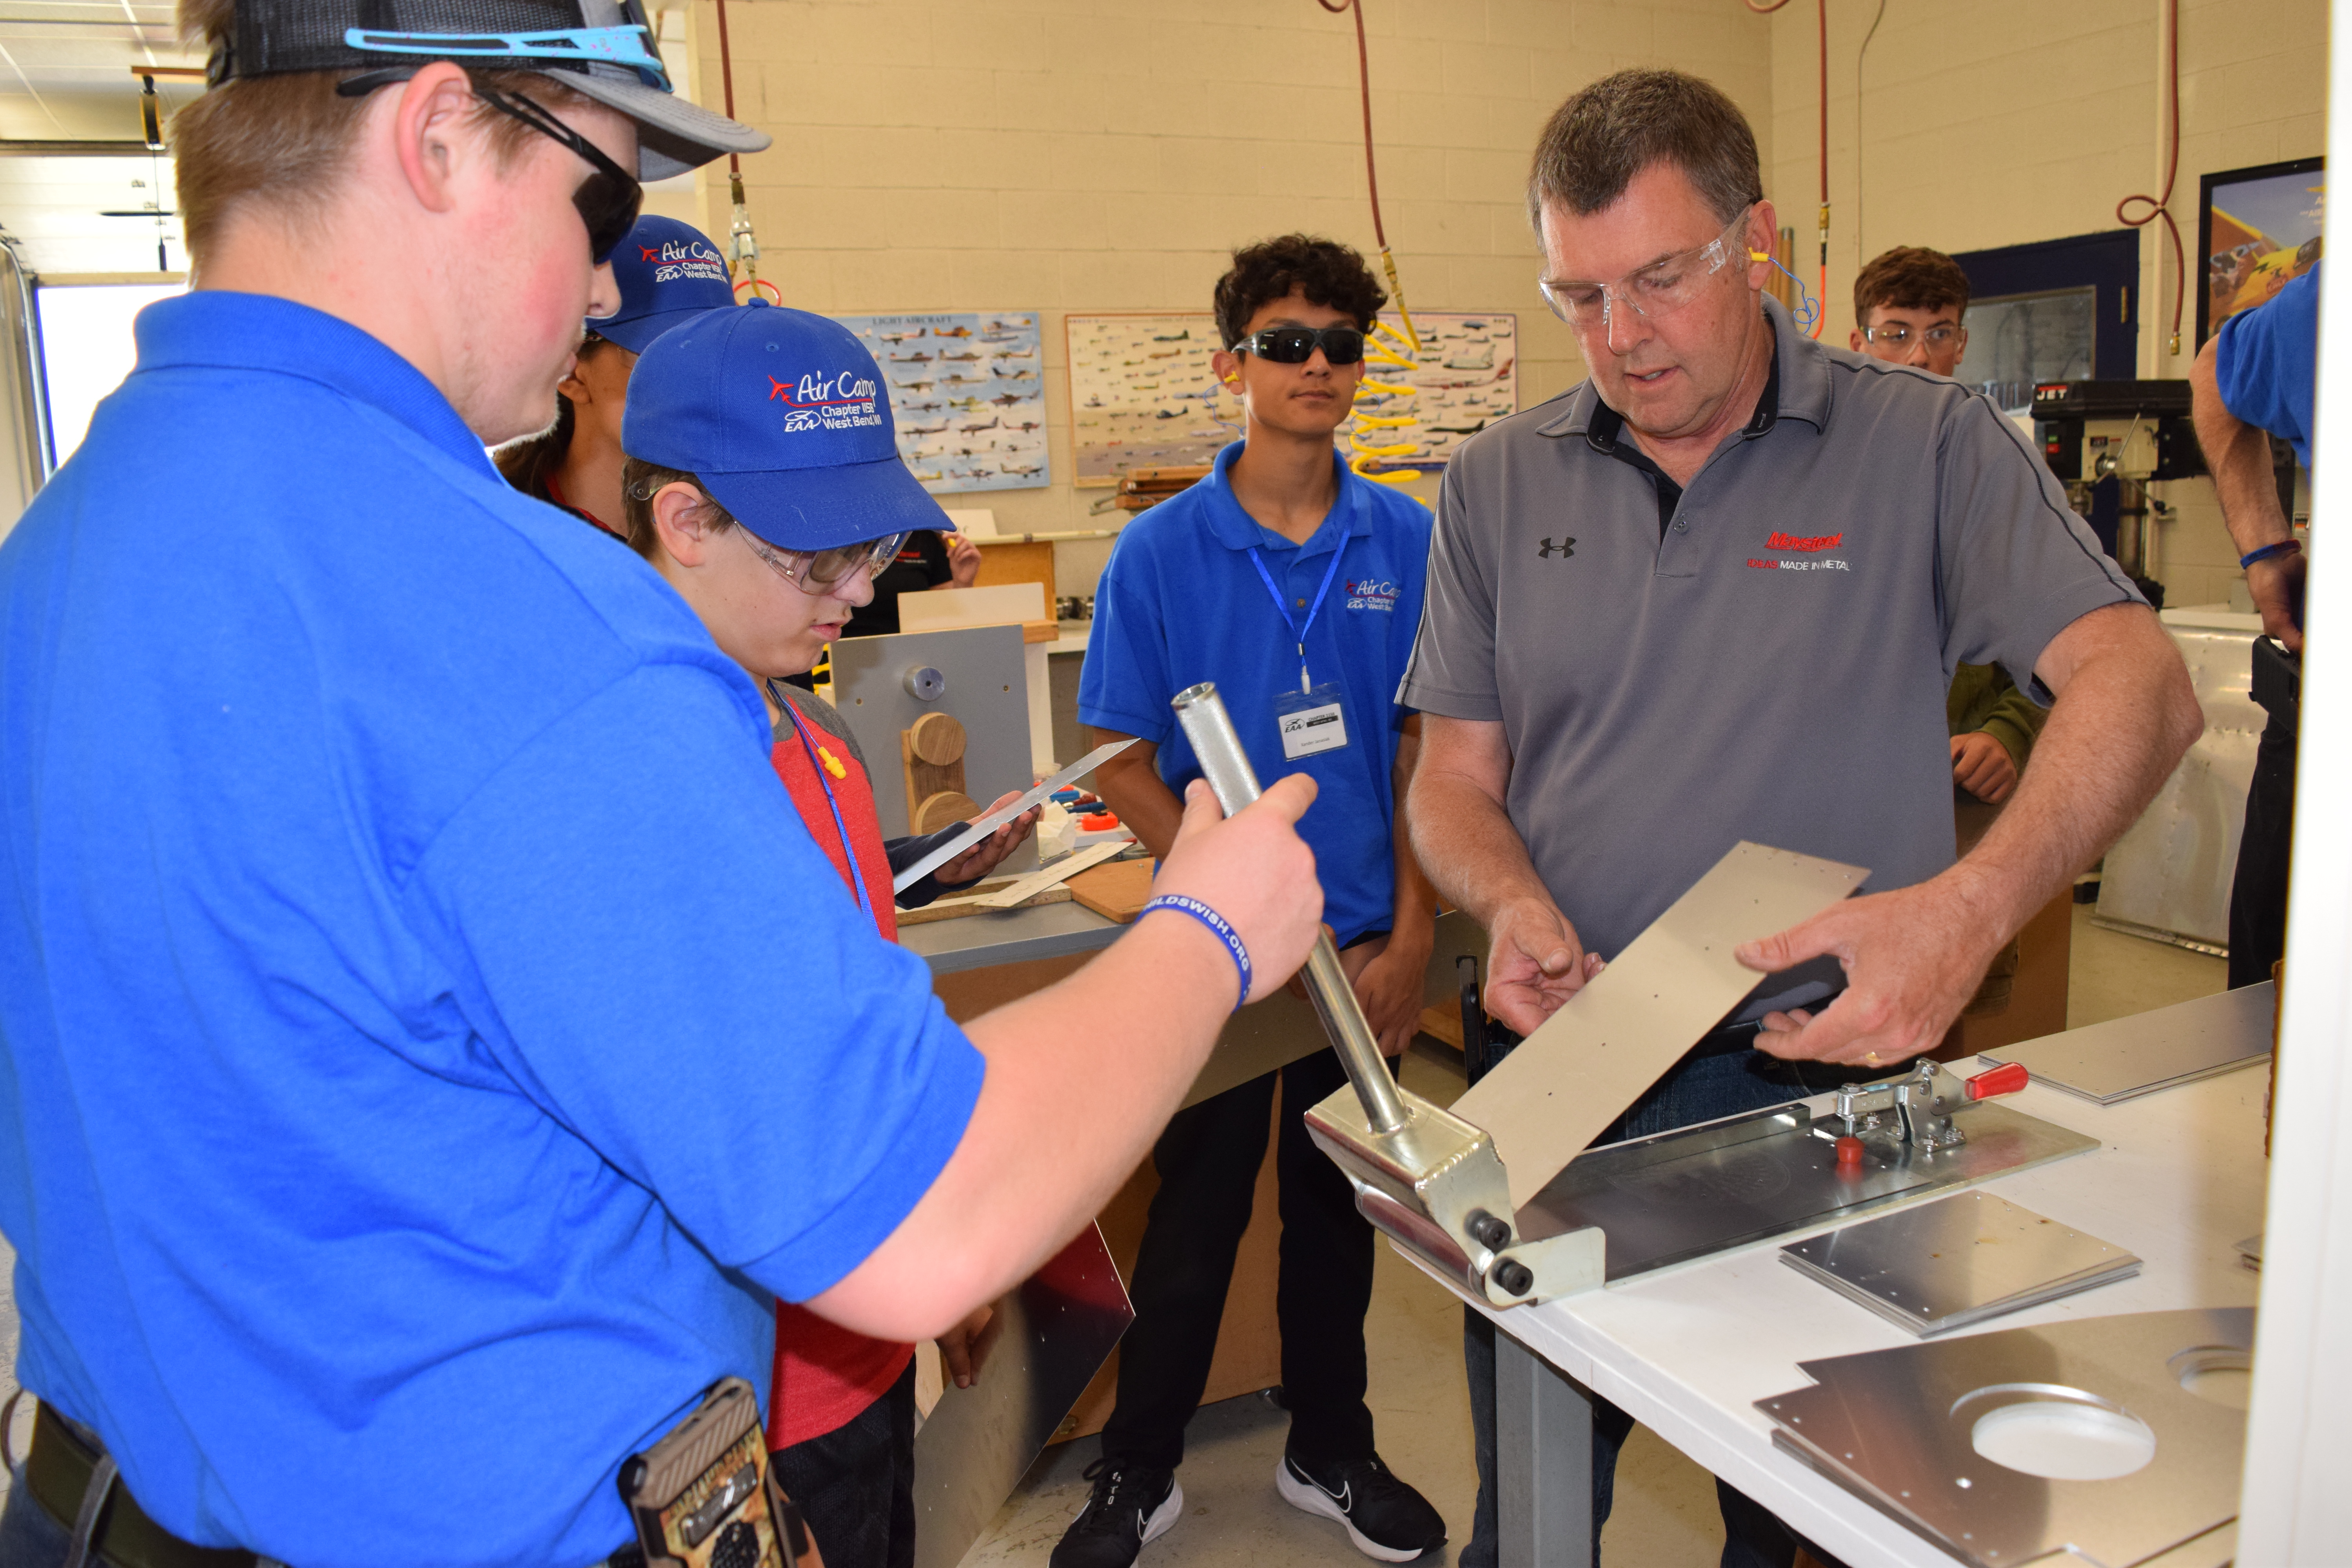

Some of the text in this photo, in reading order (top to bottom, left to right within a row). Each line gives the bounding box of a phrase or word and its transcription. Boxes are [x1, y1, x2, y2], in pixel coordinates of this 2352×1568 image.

[662, 240, 722, 271] Air Camp
[682, 262, 711, 271] Chapter
[656, 271, 679, 282] EAA
[683, 270, 707, 278] West
[872, 315, 951, 324] LIGHT AIRCRAFT
[797, 370, 876, 407] Air Camp
[2036, 389, 2067, 400] JET
[822, 404, 860, 418] Chapter
[784, 419, 815, 432] EAA
[822, 417, 853, 429] West
[1766, 532, 1843, 551] Maysteel
[1747, 559, 1850, 571] IDEAS MADE IN METAL
[1356, 579, 1379, 595] Air
[1285, 724, 1301, 733] EAA
